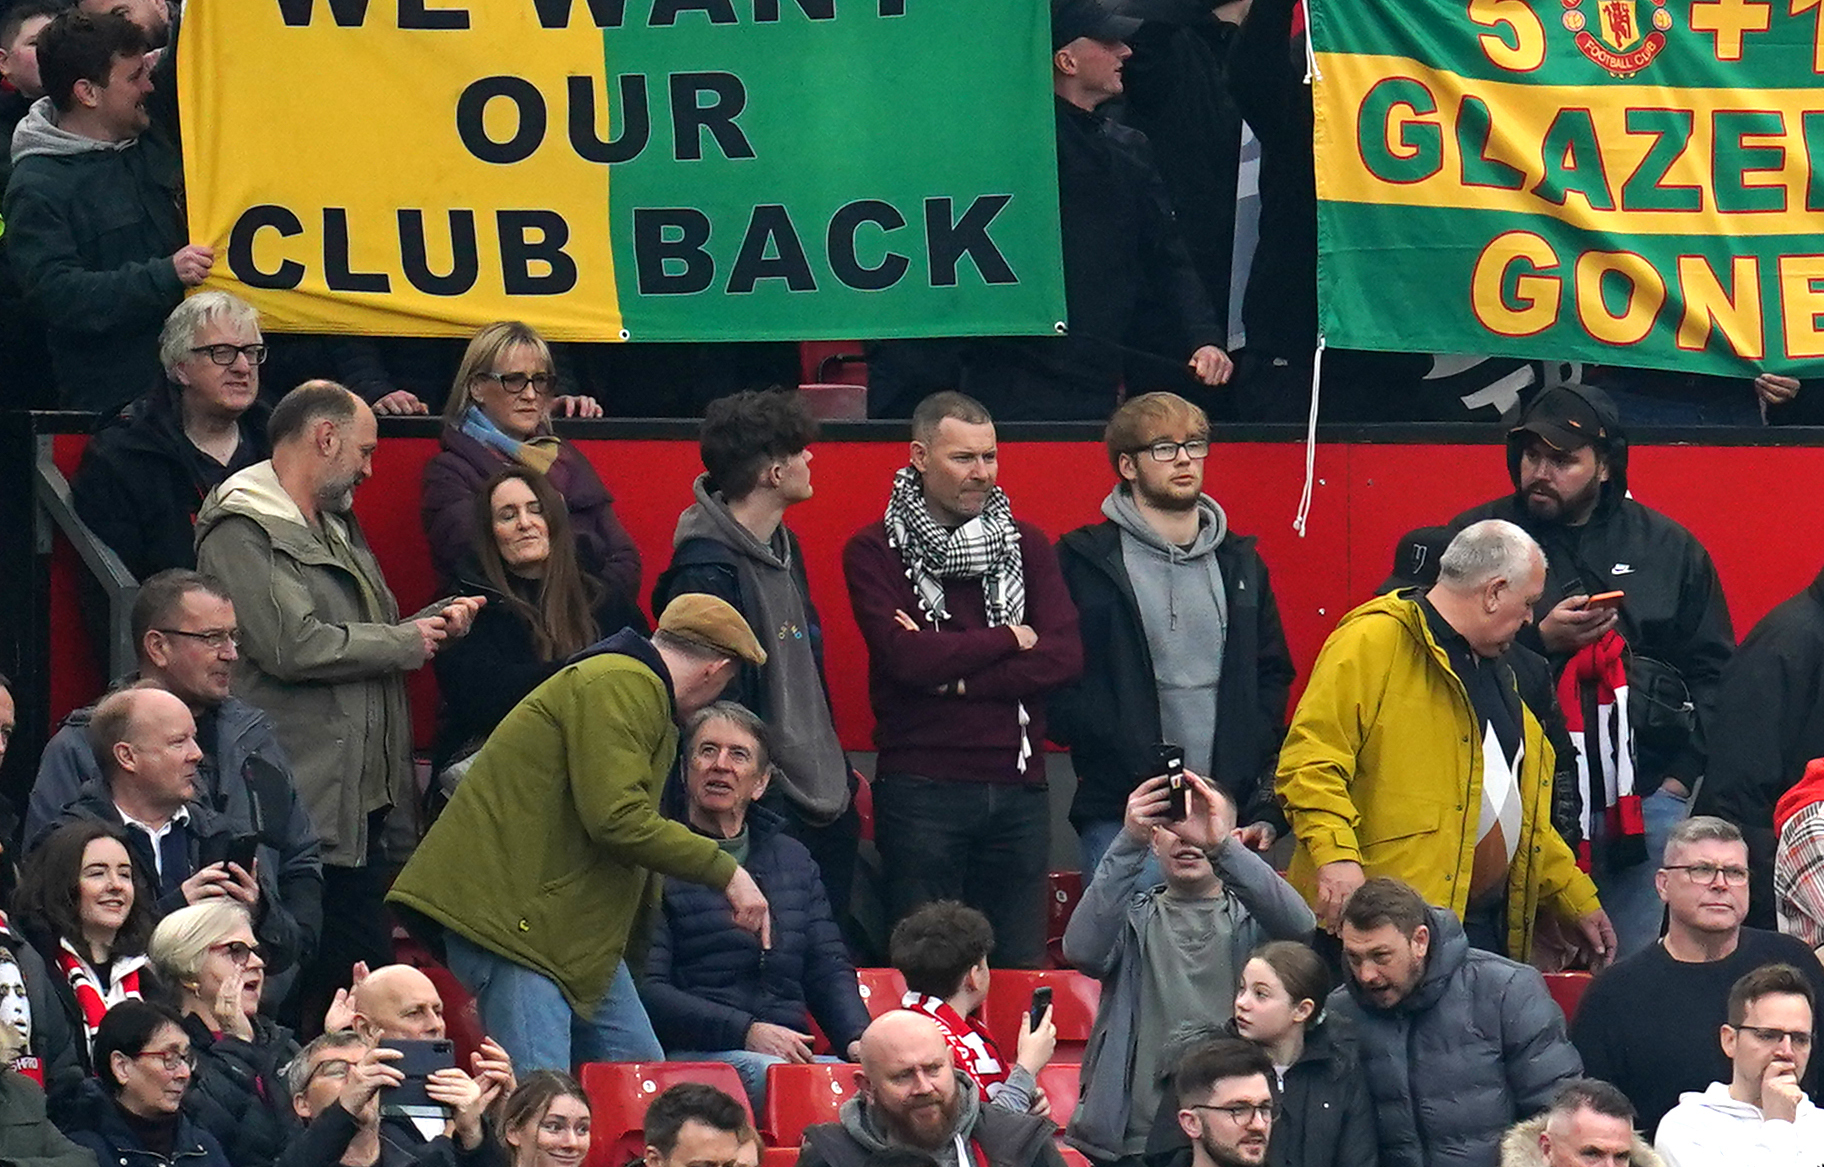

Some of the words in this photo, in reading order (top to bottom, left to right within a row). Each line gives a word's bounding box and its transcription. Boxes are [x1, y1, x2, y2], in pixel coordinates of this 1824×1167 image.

[1583, 39, 1633, 69] FOOTBALL
[1633, 40, 1658, 66] CLUB
[454, 70, 757, 165] OUR
[227, 203, 578, 298] CLUB
[632, 193, 1020, 297] BACK
